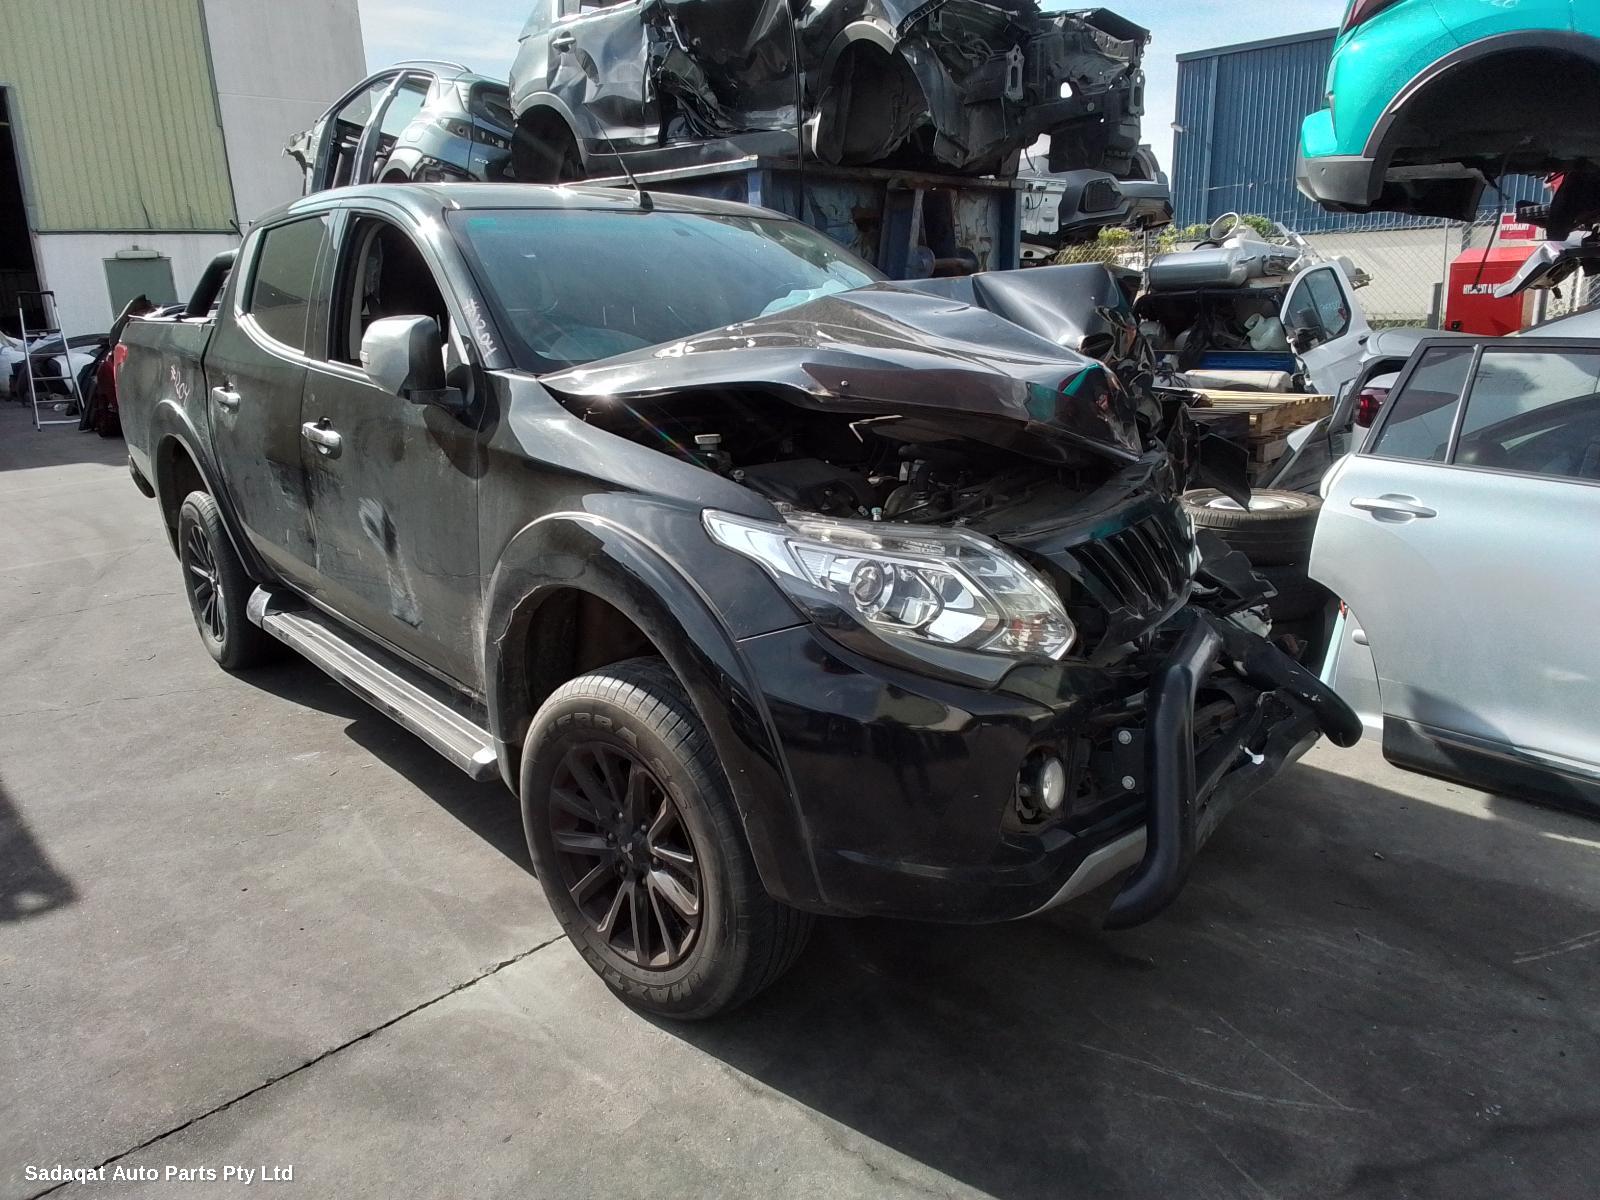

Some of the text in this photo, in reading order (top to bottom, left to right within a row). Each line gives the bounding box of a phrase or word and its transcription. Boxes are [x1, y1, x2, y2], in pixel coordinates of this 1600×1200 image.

[1501, 223, 1530, 231] HYDRANT
[1463, 283, 1488, 295] HYDNT
[544, 712, 640, 749] IERRA
